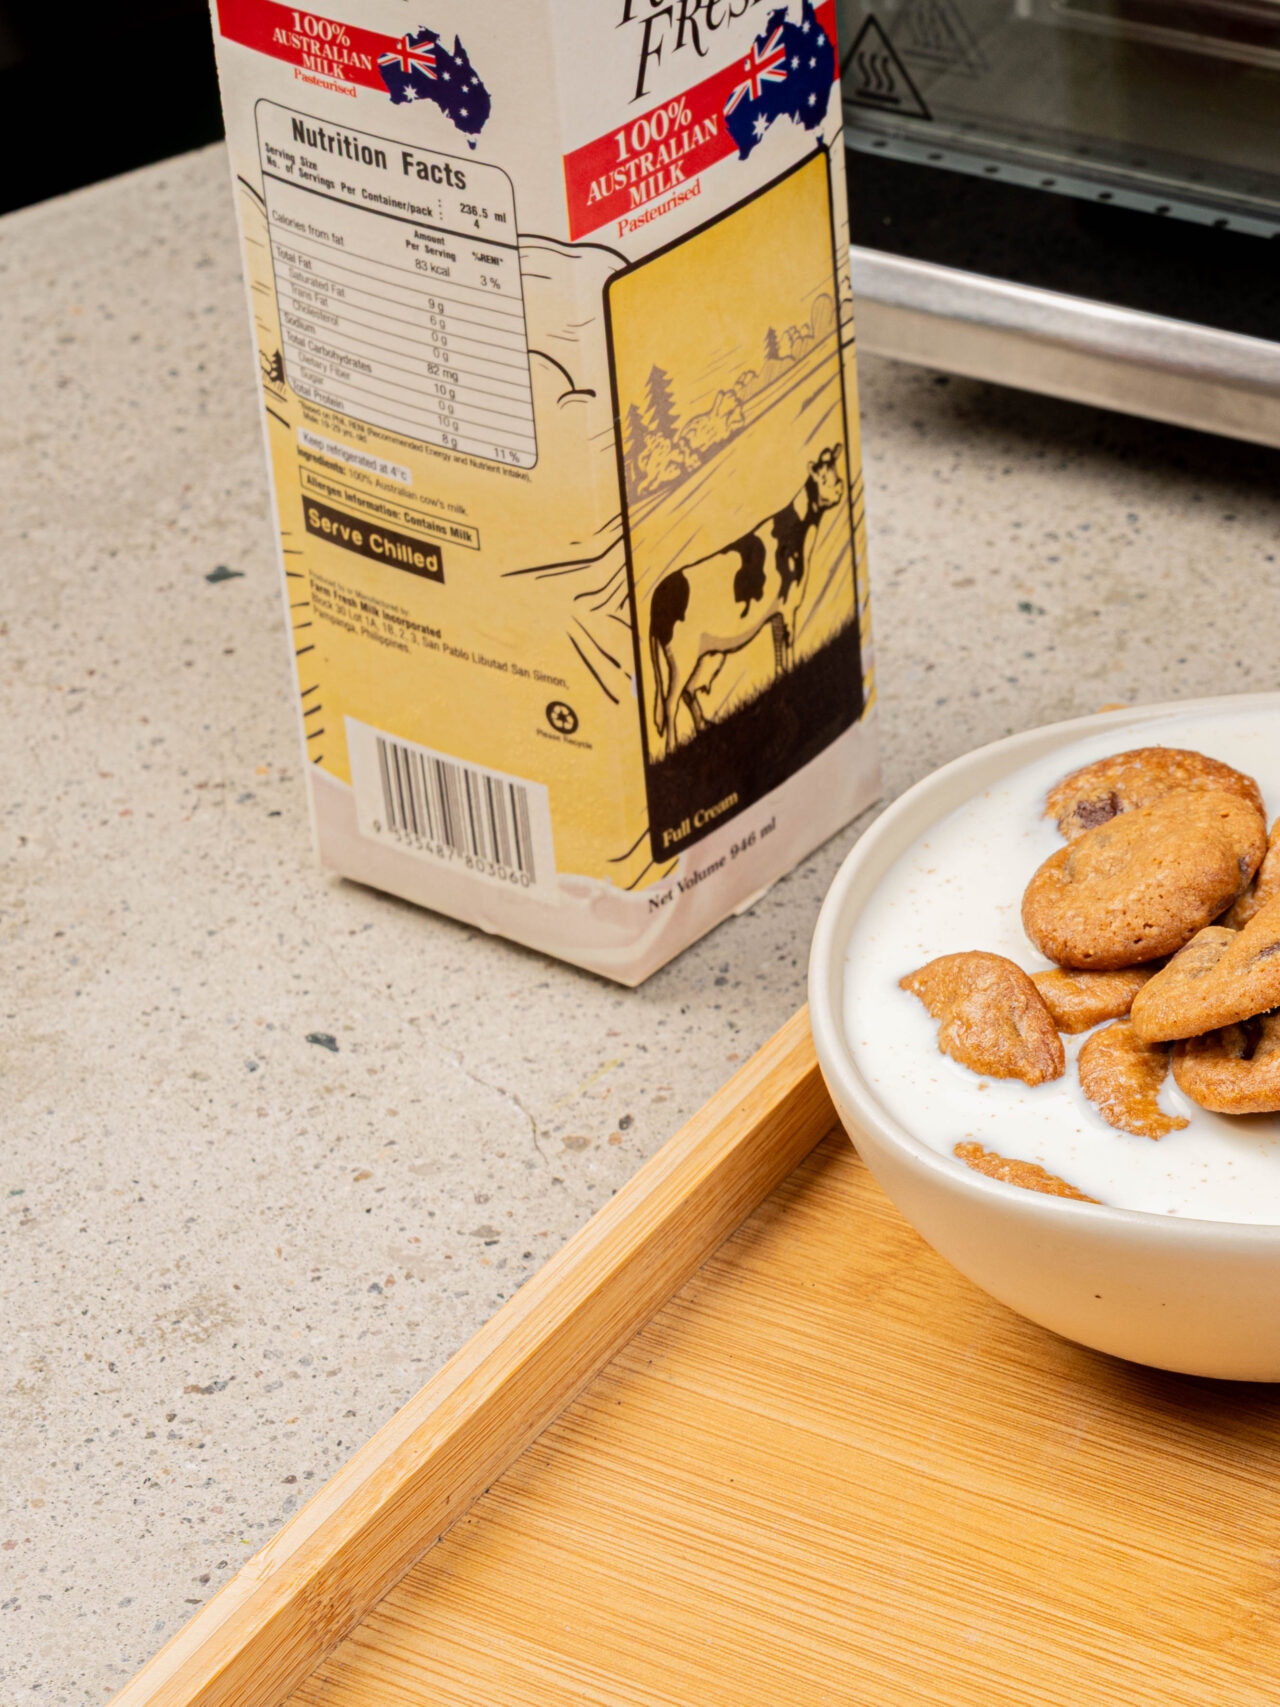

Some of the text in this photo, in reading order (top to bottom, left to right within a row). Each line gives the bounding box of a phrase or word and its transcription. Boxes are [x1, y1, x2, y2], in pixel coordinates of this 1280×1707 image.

[273, 27, 372, 71] AUSTRALIAN
[292, 12, 350, 47] 100%
[294, 68, 357, 98] Pasteurised
[302, 53, 345, 79] MILK
[291, 117, 466, 190] Nutrition Facts
[586, 114, 718, 206] AUSTRALIAN
[614, 96, 692, 163] 100%
[265, 142, 295, 165] Serving
[300, 156, 318, 171] Size
[460, 202, 488, 219] 236.5
[494, 212, 506, 223] ml
[266, 155, 280, 169] No.
[286, 163, 293, 174] of
[299, 168, 335, 189] Servings
[341, 182, 355, 195] Per
[361, 188, 433, 217] Container/pack
[474, 219, 480, 229] 4
[617, 179, 701, 238] Pasteurised
[630, 160, 686, 209] MILK
[272, 210, 305, 232] Calories
[308, 224, 329, 241] from
[332, 233, 344, 246] fat
[415, 258, 428, 272] 83
[430, 263, 450, 277] kcal
[405, 239, 456, 262] Per Serving
[414, 230, 445, 245] Amount
[276, 246, 444, 315] Total Fat 9 g
[288, 266, 446, 331] Saturated Fat 6 g
[284, 311, 458, 383] Sodium 82 mg
[291, 282, 312, 300] Trans
[314, 292, 328, 307] Fat
[441, 336, 447, 347] g
[292, 299, 339, 326] Cholesterol
[442, 352, 449, 363] g
[287, 330, 455, 401] Total Carbohydrates 10 g
[298, 349, 328, 373] Dietary
[447, 405, 454, 415] g
[293, 380, 311, 397] Total
[313, 389, 345, 410] Protein
[451, 438, 457, 450] g
[494, 447, 505, 460] 11
[509, 451, 520, 464] %
[300, 365, 459, 432] Sugar 10 g
[296, 444, 346, 476] Ingredients:
[375, 479, 418, 500] Australian
[419, 495, 445, 509] cow's
[303, 432, 324, 451] Keep
[326, 443, 377, 470] refrigerated
[379, 463, 388, 474] at
[425, 445, 451, 462] Energy
[453, 455, 468, 466] and
[470, 458, 501, 474] Nutrient
[306, 474, 472, 542] Allergen Information: Contains Milk
[308, 507, 438, 572] Serve Chilled
[310, 578, 441, 639] Farm Fresh Milk Incorporated
[311, 591, 332, 609] Block
[348, 609, 362, 622] Lot
[422, 636, 440, 652] San
[442, 643, 469, 661] Pablo
[472, 652, 508, 672] Libutad
[511, 664, 530, 679] San
[533, 670, 570, 690] Simon,
[536, 728, 593, 750] Please Recycle
[663, 791, 738, 848] Full Cream
[465, 854, 530, 888] 803060
[648, 816, 776, 914] Net Volume 946 ml
